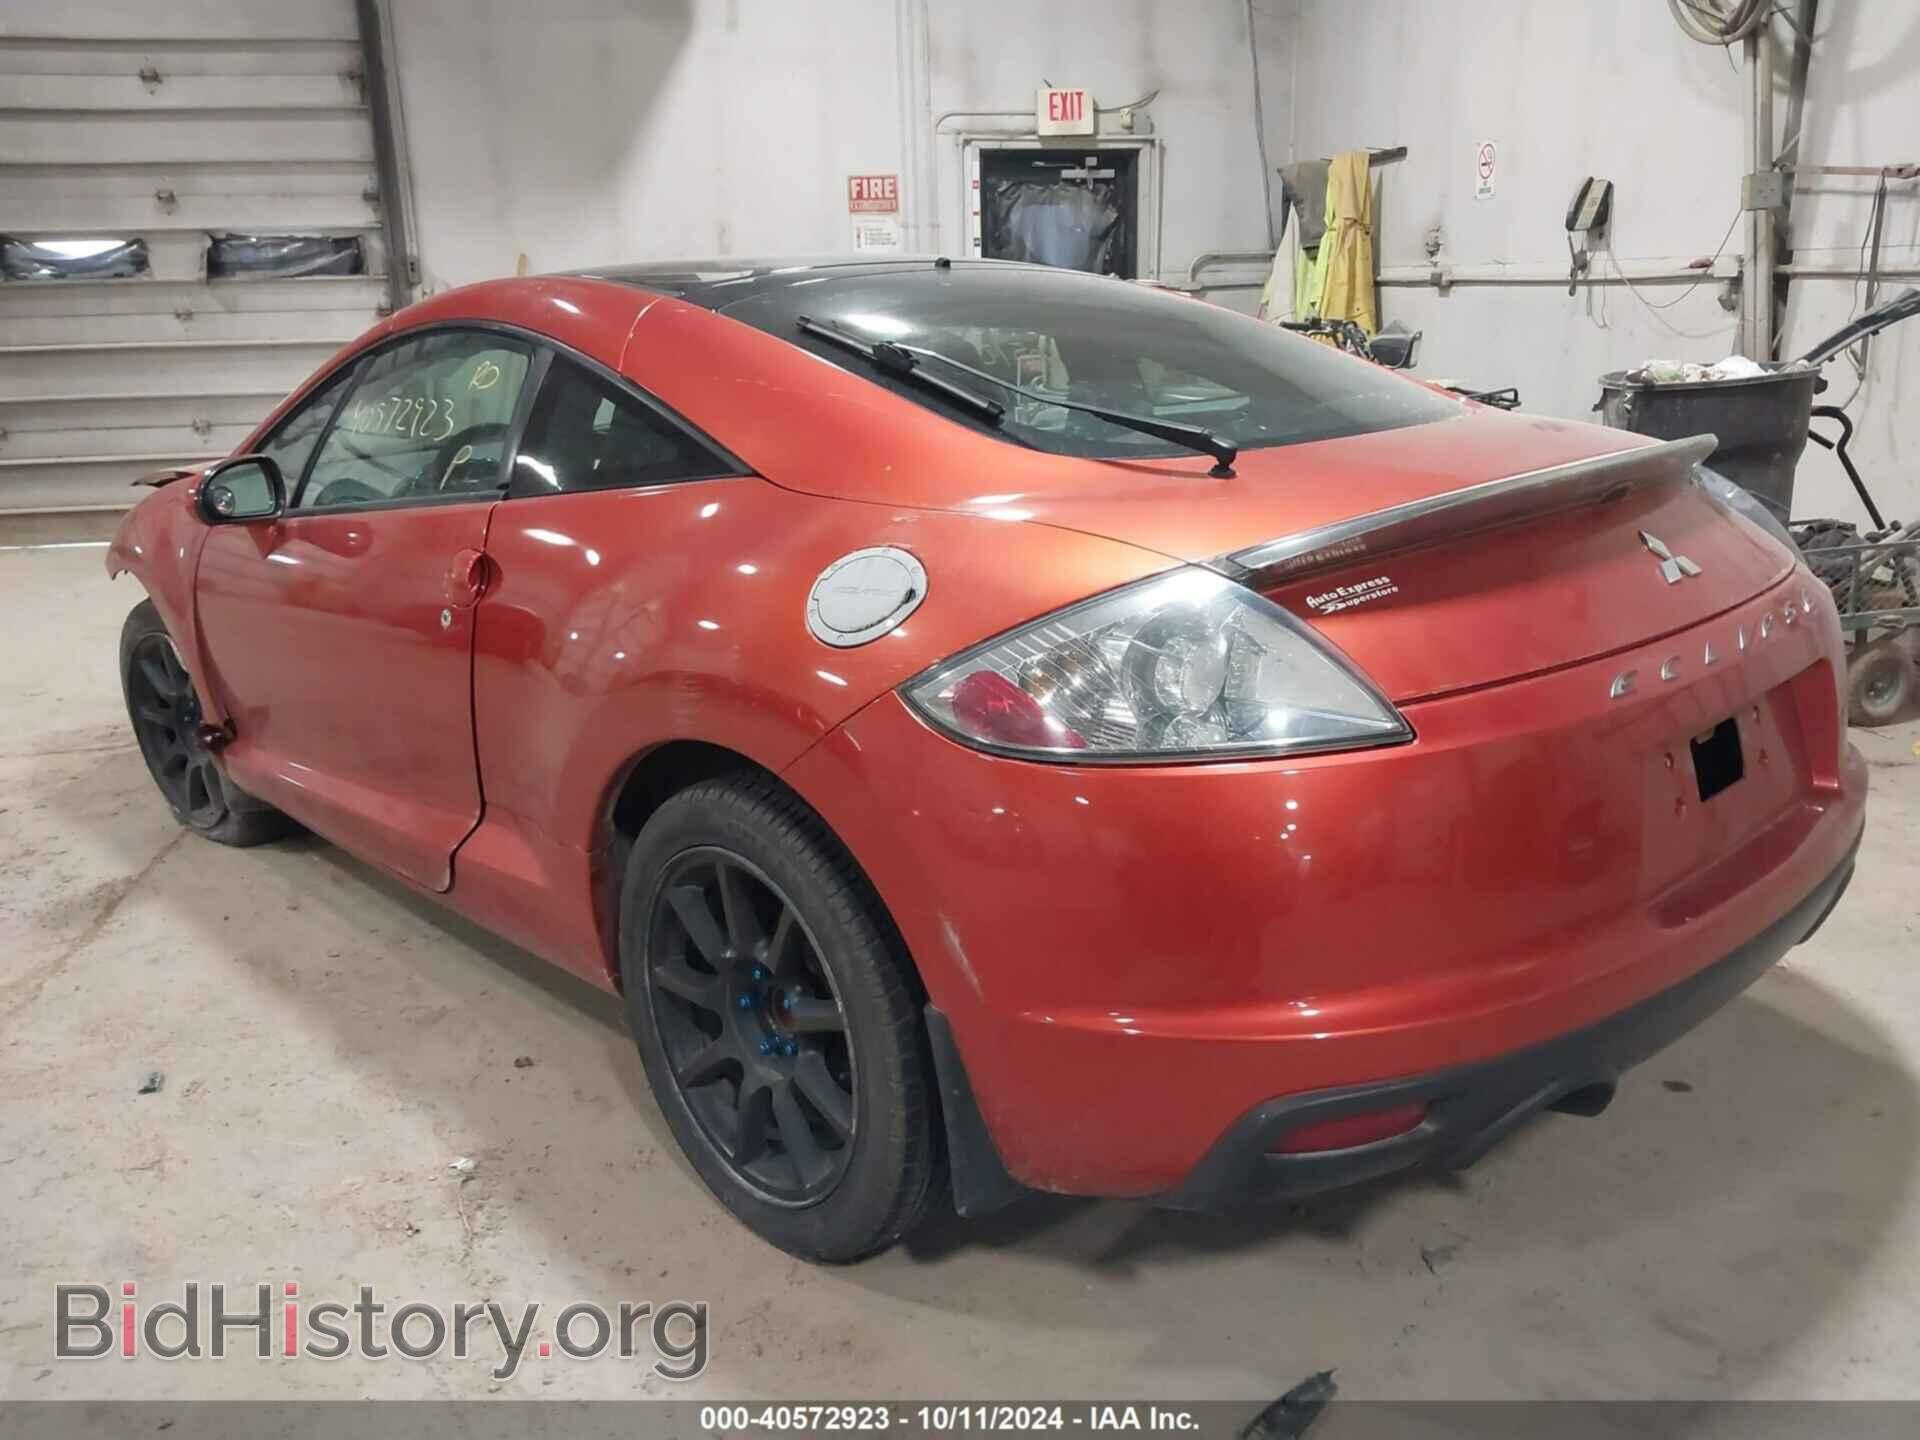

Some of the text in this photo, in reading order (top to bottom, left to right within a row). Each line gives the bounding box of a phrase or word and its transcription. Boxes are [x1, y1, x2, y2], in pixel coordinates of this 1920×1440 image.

[1049, 91, 1084, 121] EXIT
[850, 178, 896, 199] FIRE
[351, 397, 454, 441] 40572923
[1610, 588, 1815, 698] ECLIPSE
